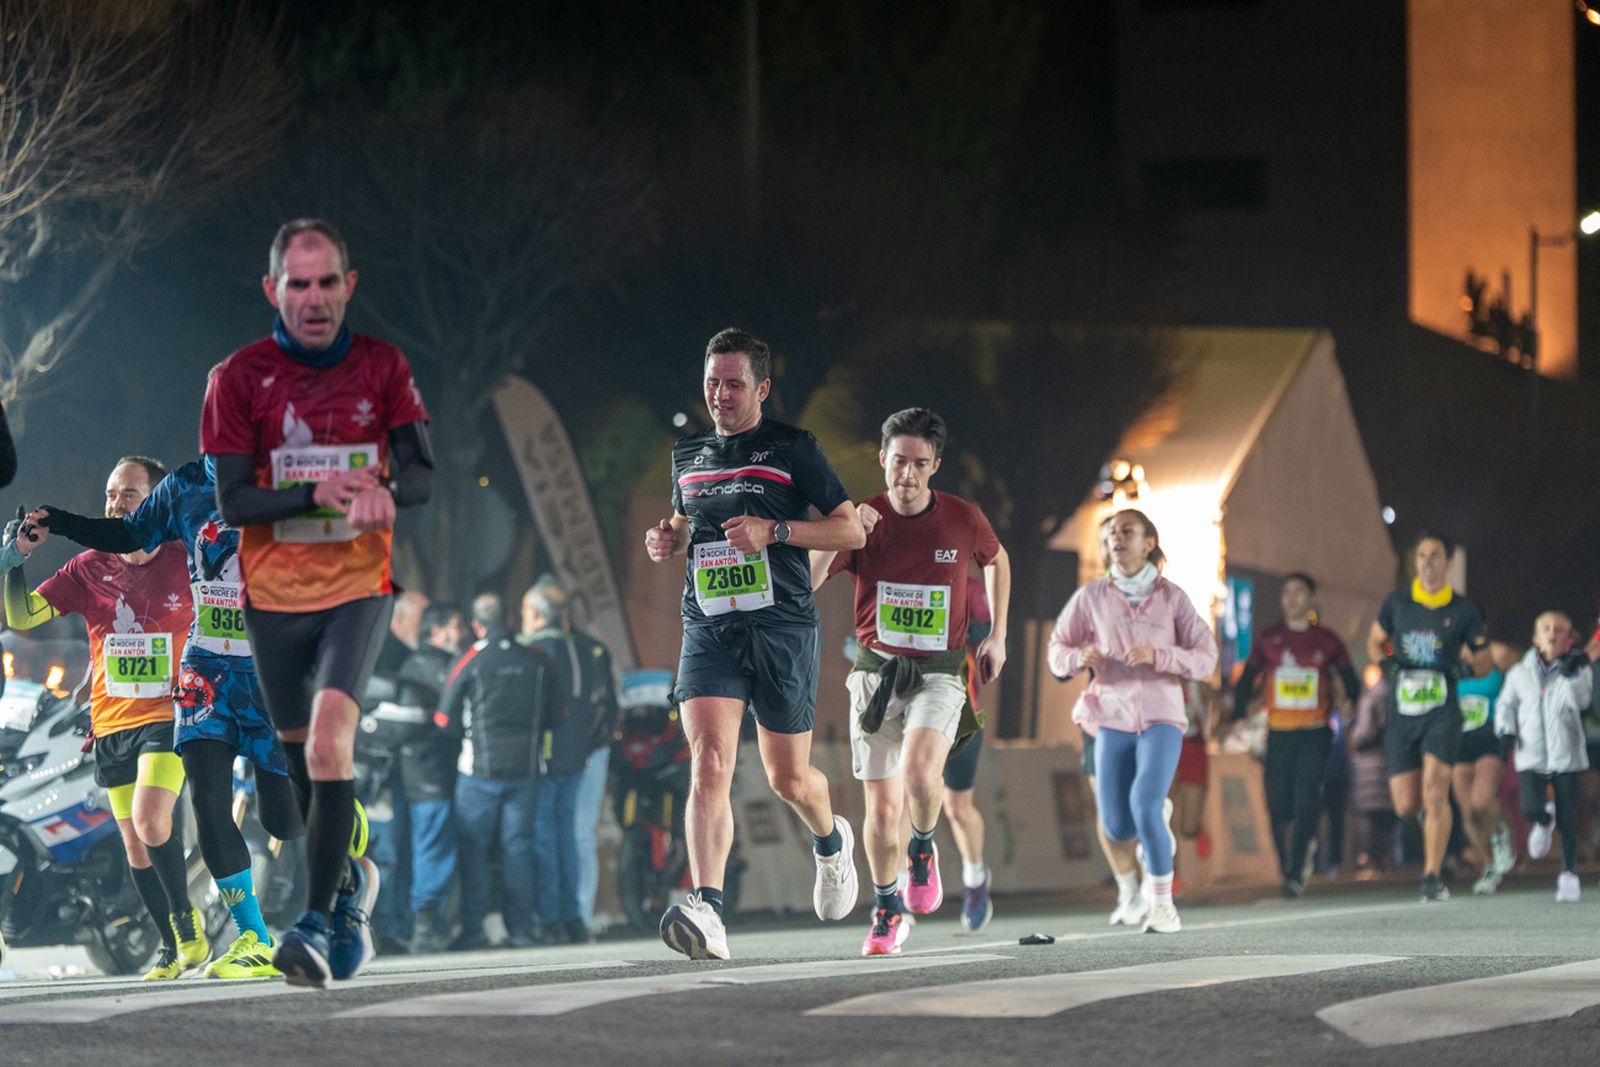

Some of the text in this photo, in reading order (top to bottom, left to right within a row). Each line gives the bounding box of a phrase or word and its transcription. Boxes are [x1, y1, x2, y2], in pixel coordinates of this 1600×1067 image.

[297, 459, 326, 468] NOCHE
[329, 458, 339, 467] DE
[284, 470, 305, 480] SAN
[707, 549, 727, 558] NOCHE
[728, 548, 736, 556] DE
[935, 549, 958, 560] EA7
[700, 560, 713, 568] SAN
[706, 564, 757, 590] 2360
[210, 588, 229, 597] NOCHE
[893, 591, 914, 599] NOCHE
[203, 597, 215, 606] SAN
[885, 597, 899, 605] SAN
[891, 607, 935, 629] 4912
[118, 656, 156, 676] 8721
